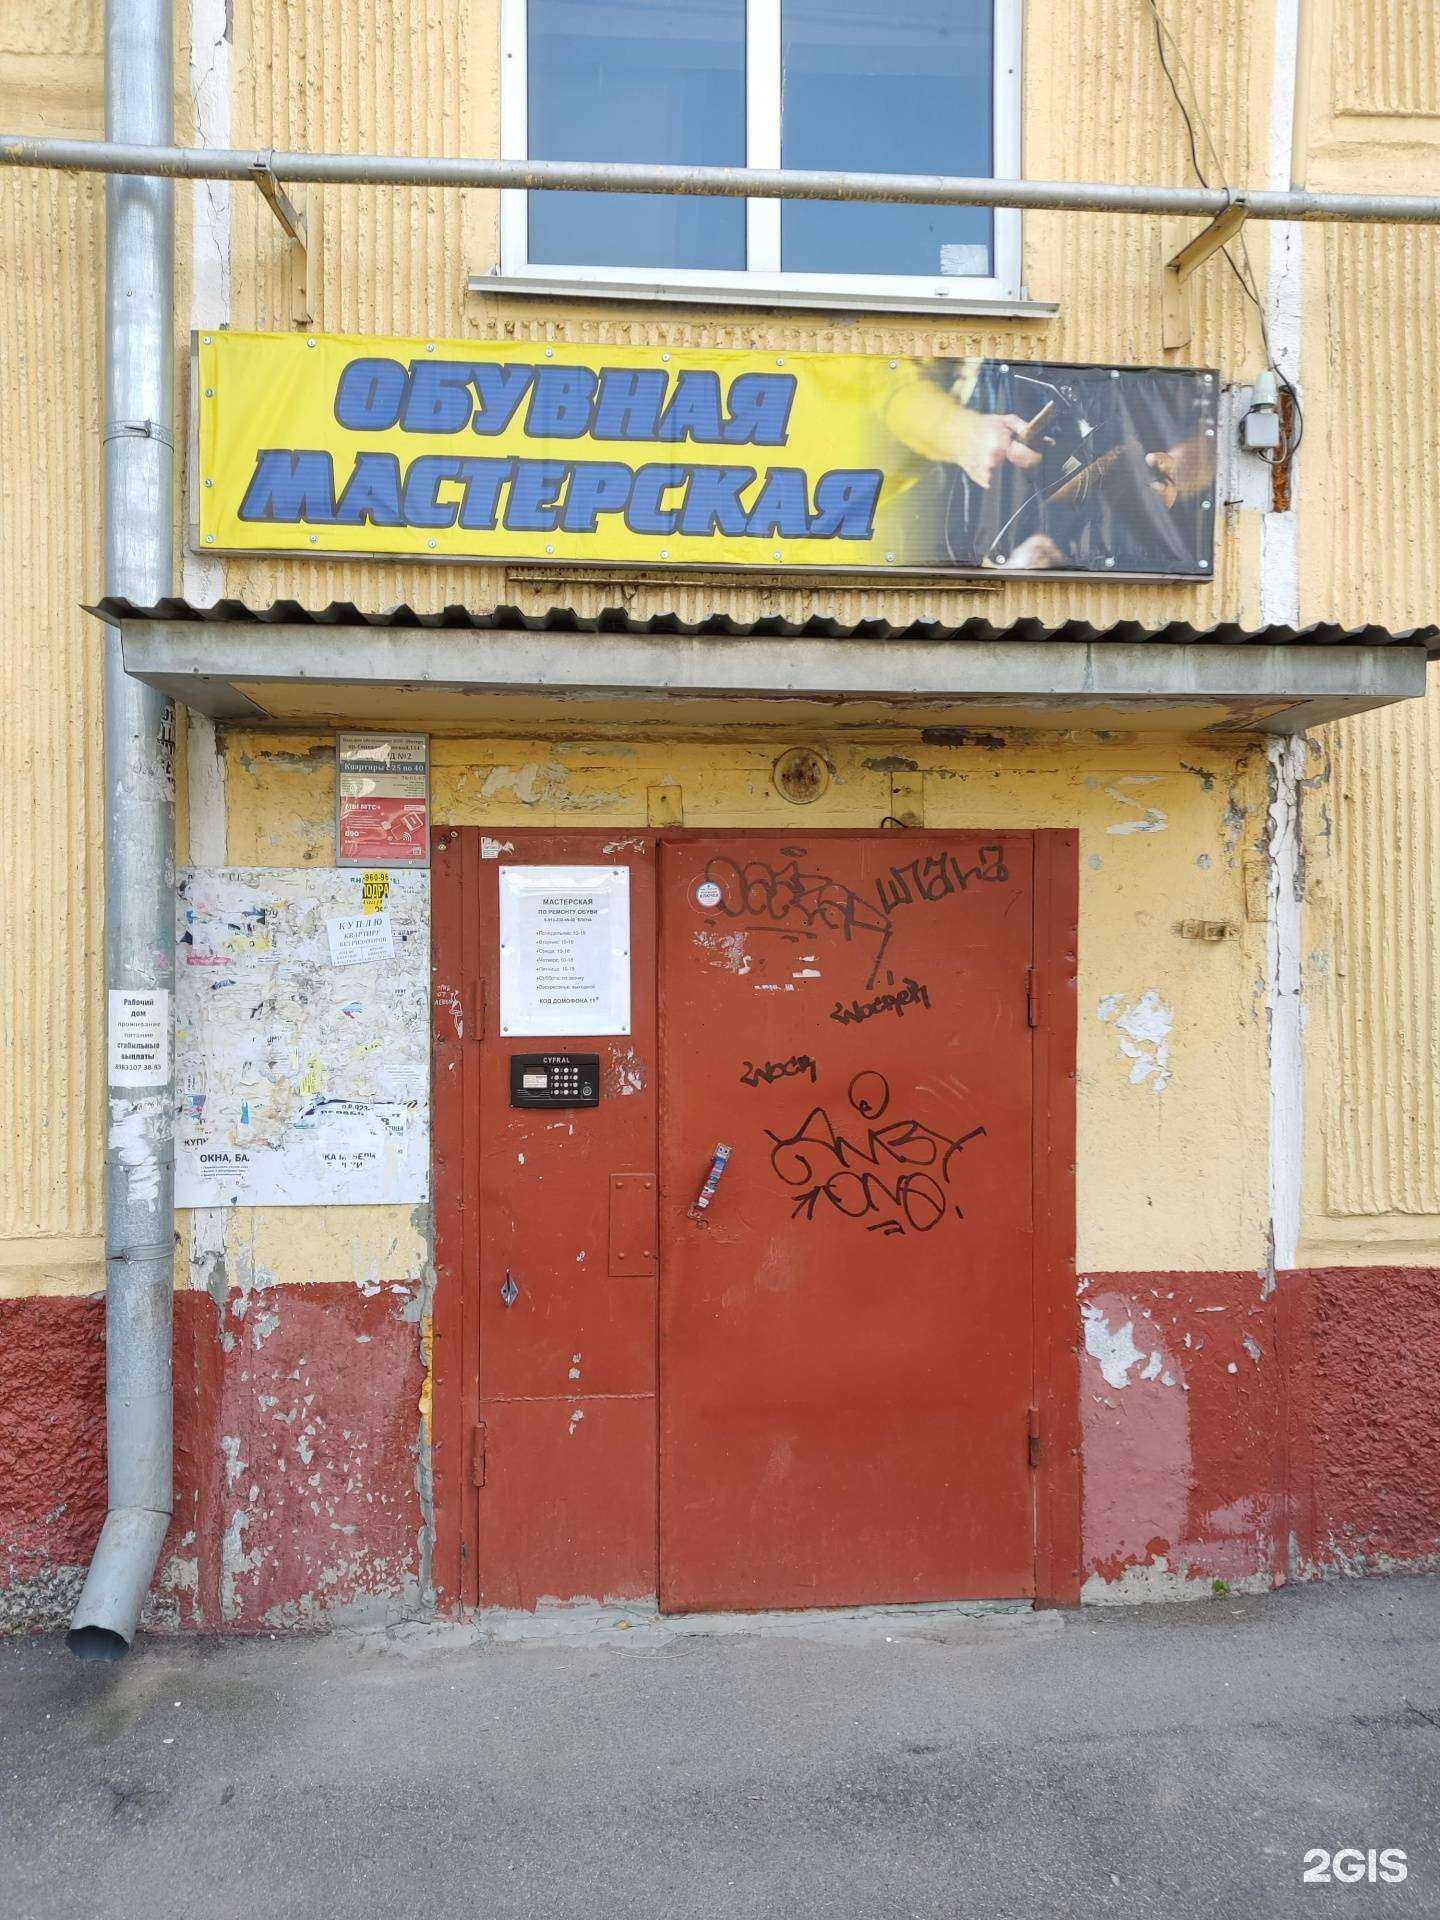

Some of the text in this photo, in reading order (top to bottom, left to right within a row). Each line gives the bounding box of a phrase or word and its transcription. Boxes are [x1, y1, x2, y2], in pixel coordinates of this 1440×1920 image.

[334, 357, 798, 446] ОБУВНАЯ
[237, 448, 885, 540] МАСТЕРСКАЯ
[199, 1153, 231, 1164] ОКНА,
